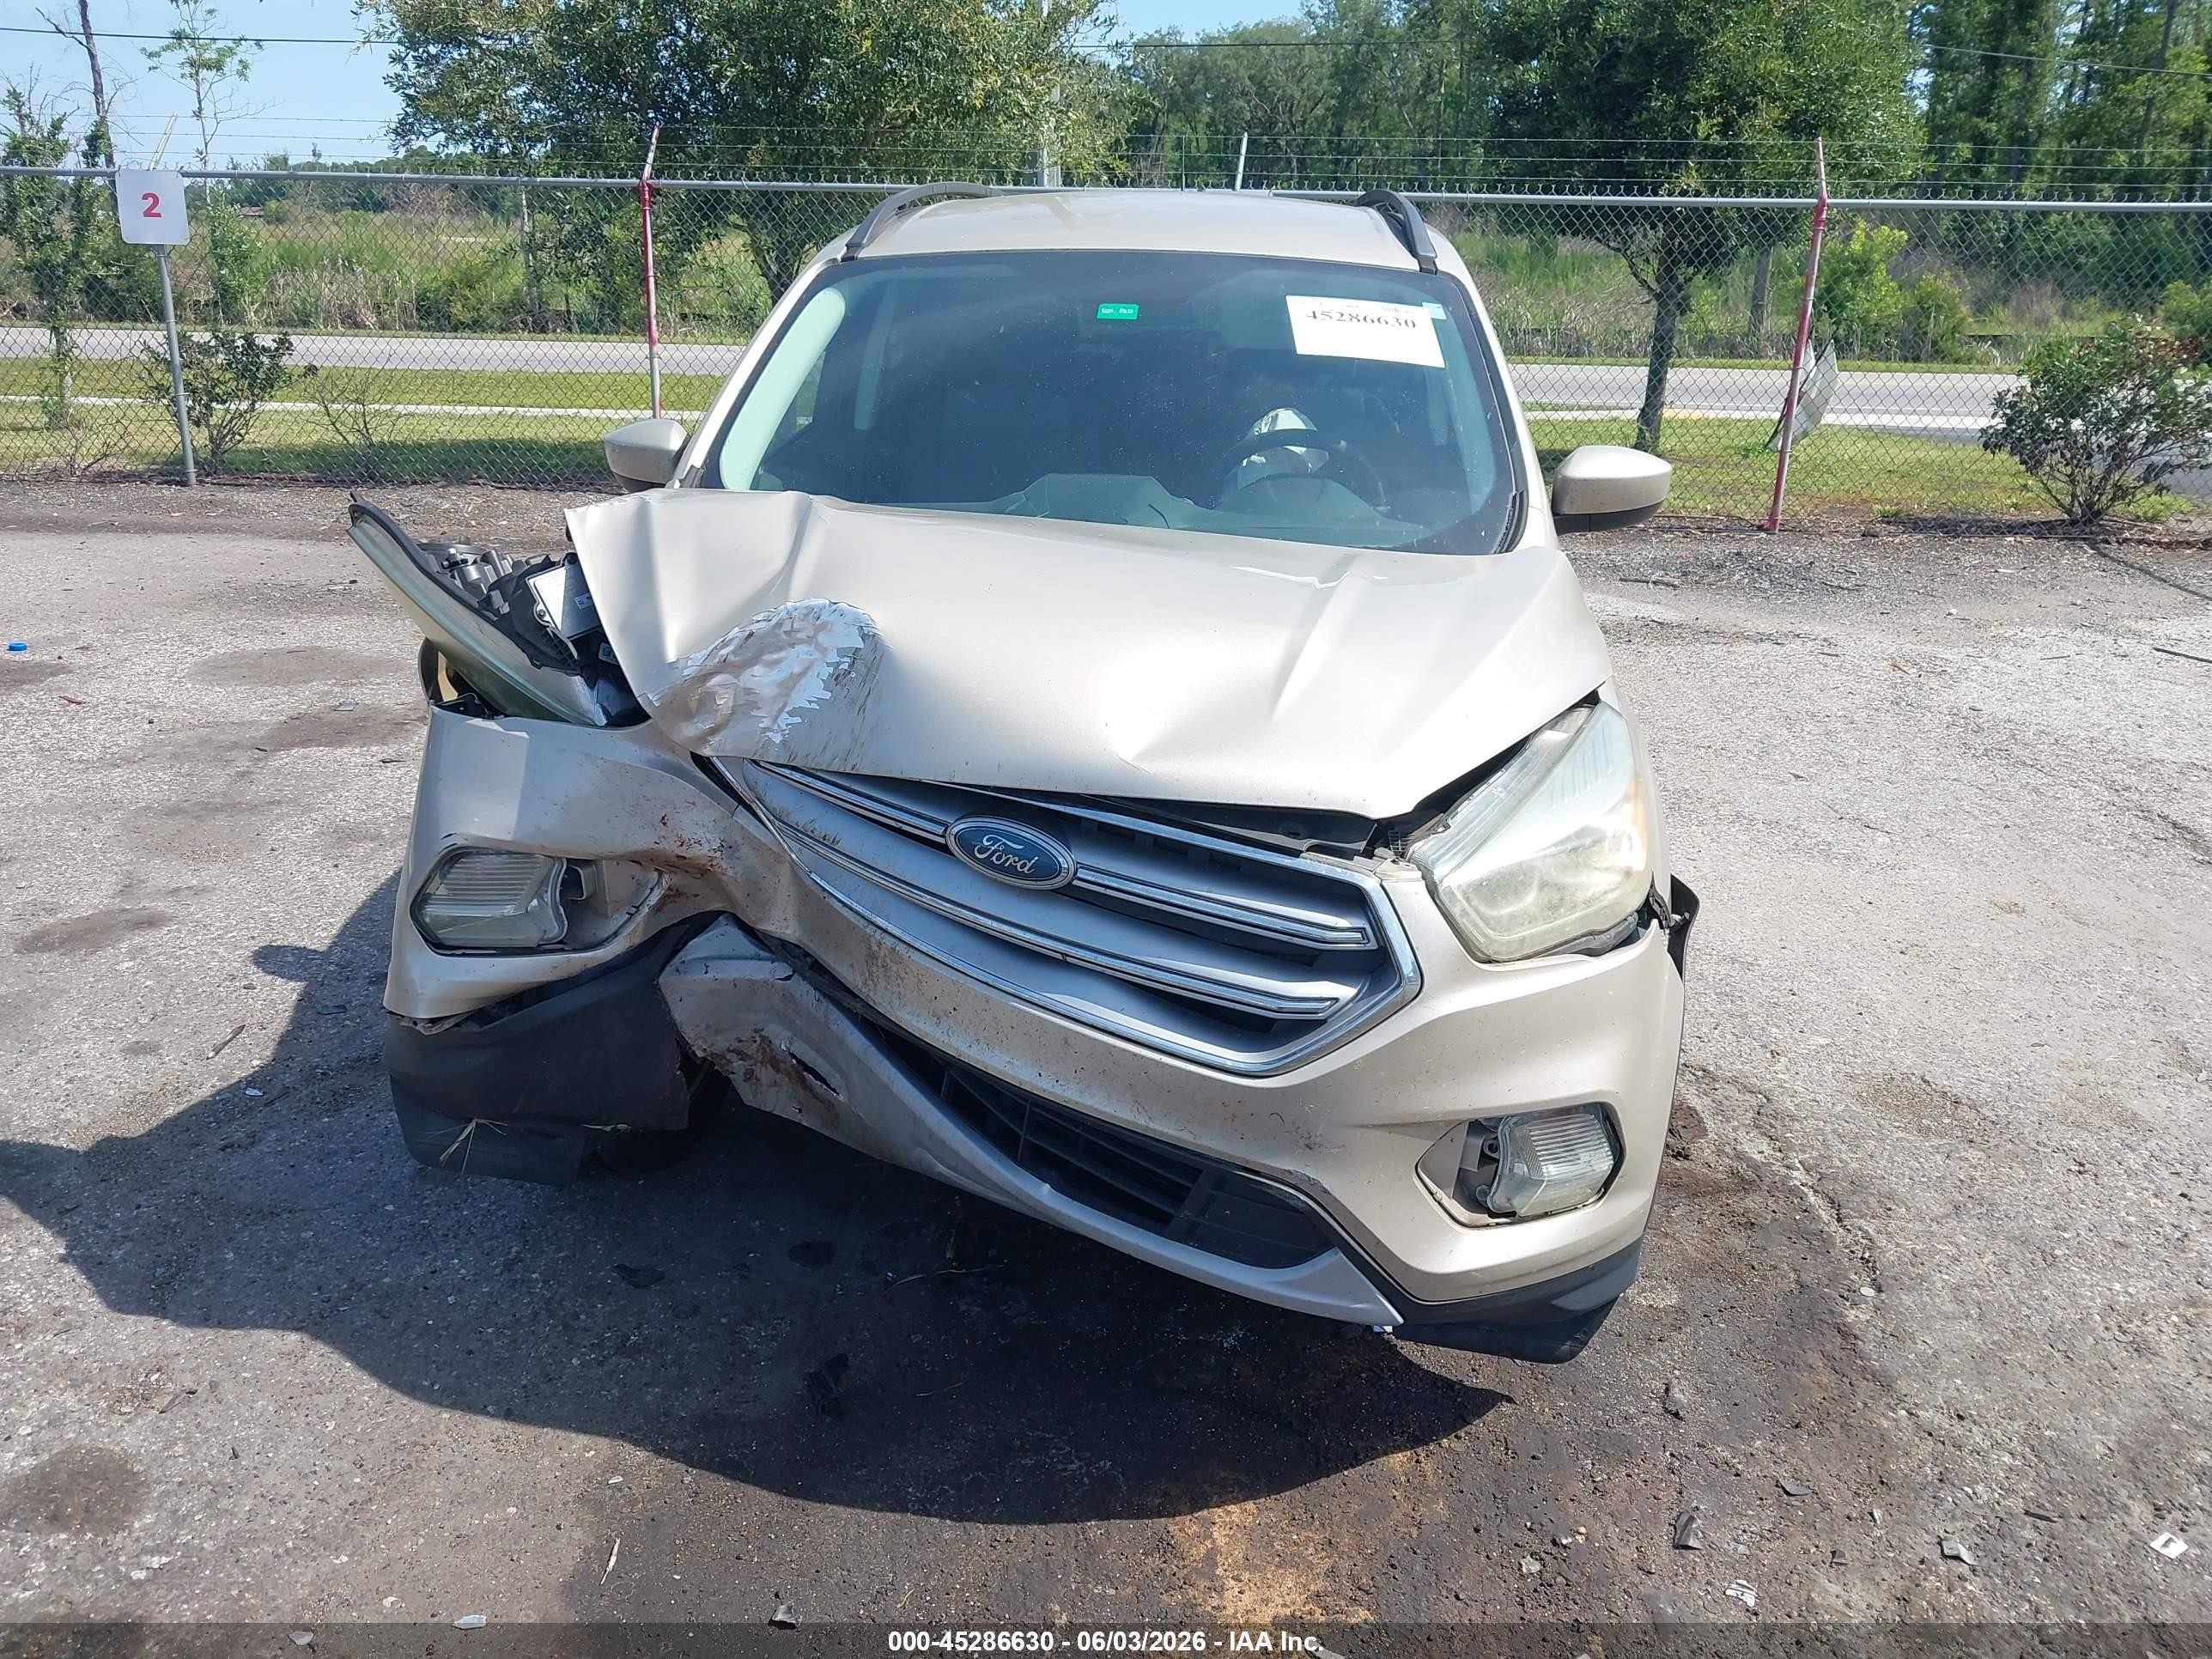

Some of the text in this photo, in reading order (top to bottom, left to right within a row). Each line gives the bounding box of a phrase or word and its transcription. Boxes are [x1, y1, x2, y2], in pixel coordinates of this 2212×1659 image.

[142, 192, 161, 218] 2
[1305, 310, 1417, 329] 45286630
[974, 834, 1039, 874] Ford
